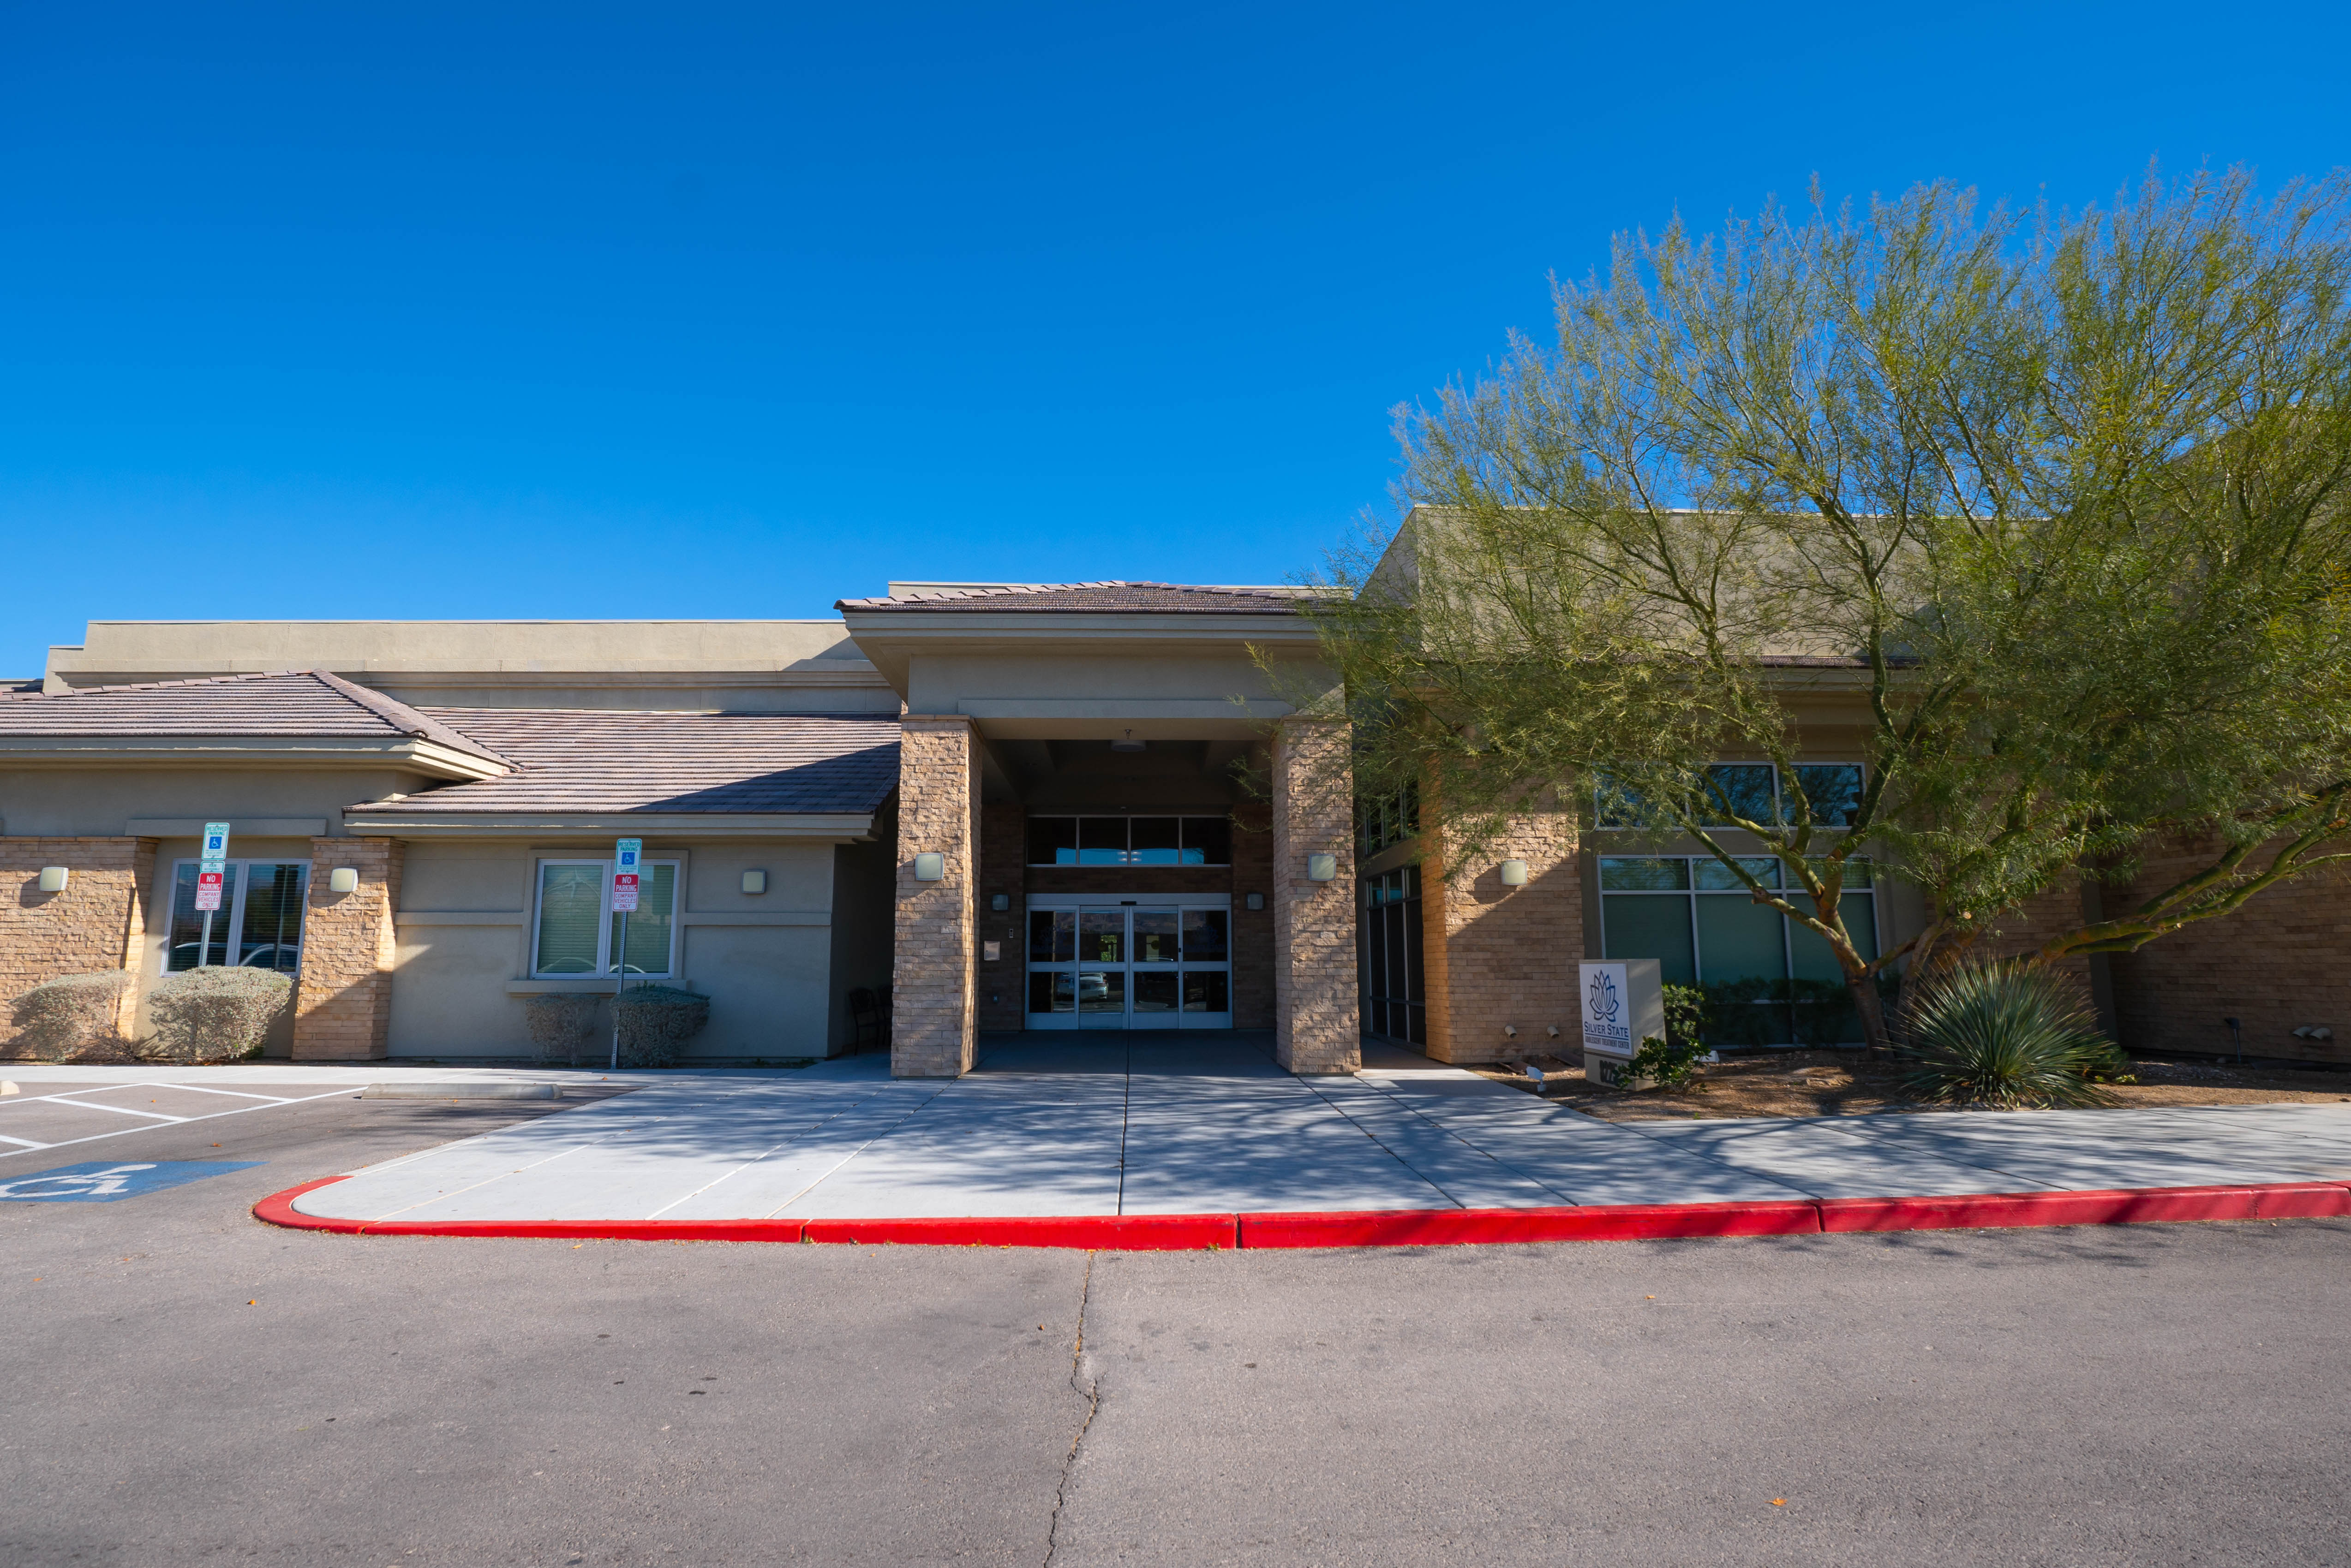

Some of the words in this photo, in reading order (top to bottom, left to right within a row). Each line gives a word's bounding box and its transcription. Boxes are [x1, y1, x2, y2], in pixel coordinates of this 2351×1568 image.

[1584, 1021, 1606, 1034] SILVER
[1607, 1024, 1629, 1037] STATE
[1585, 1036, 1601, 1045] ADOLESCENT
[1602, 1037, 1617, 1047] TREATMENT
[1618, 1040, 1629, 1049] CENTER
